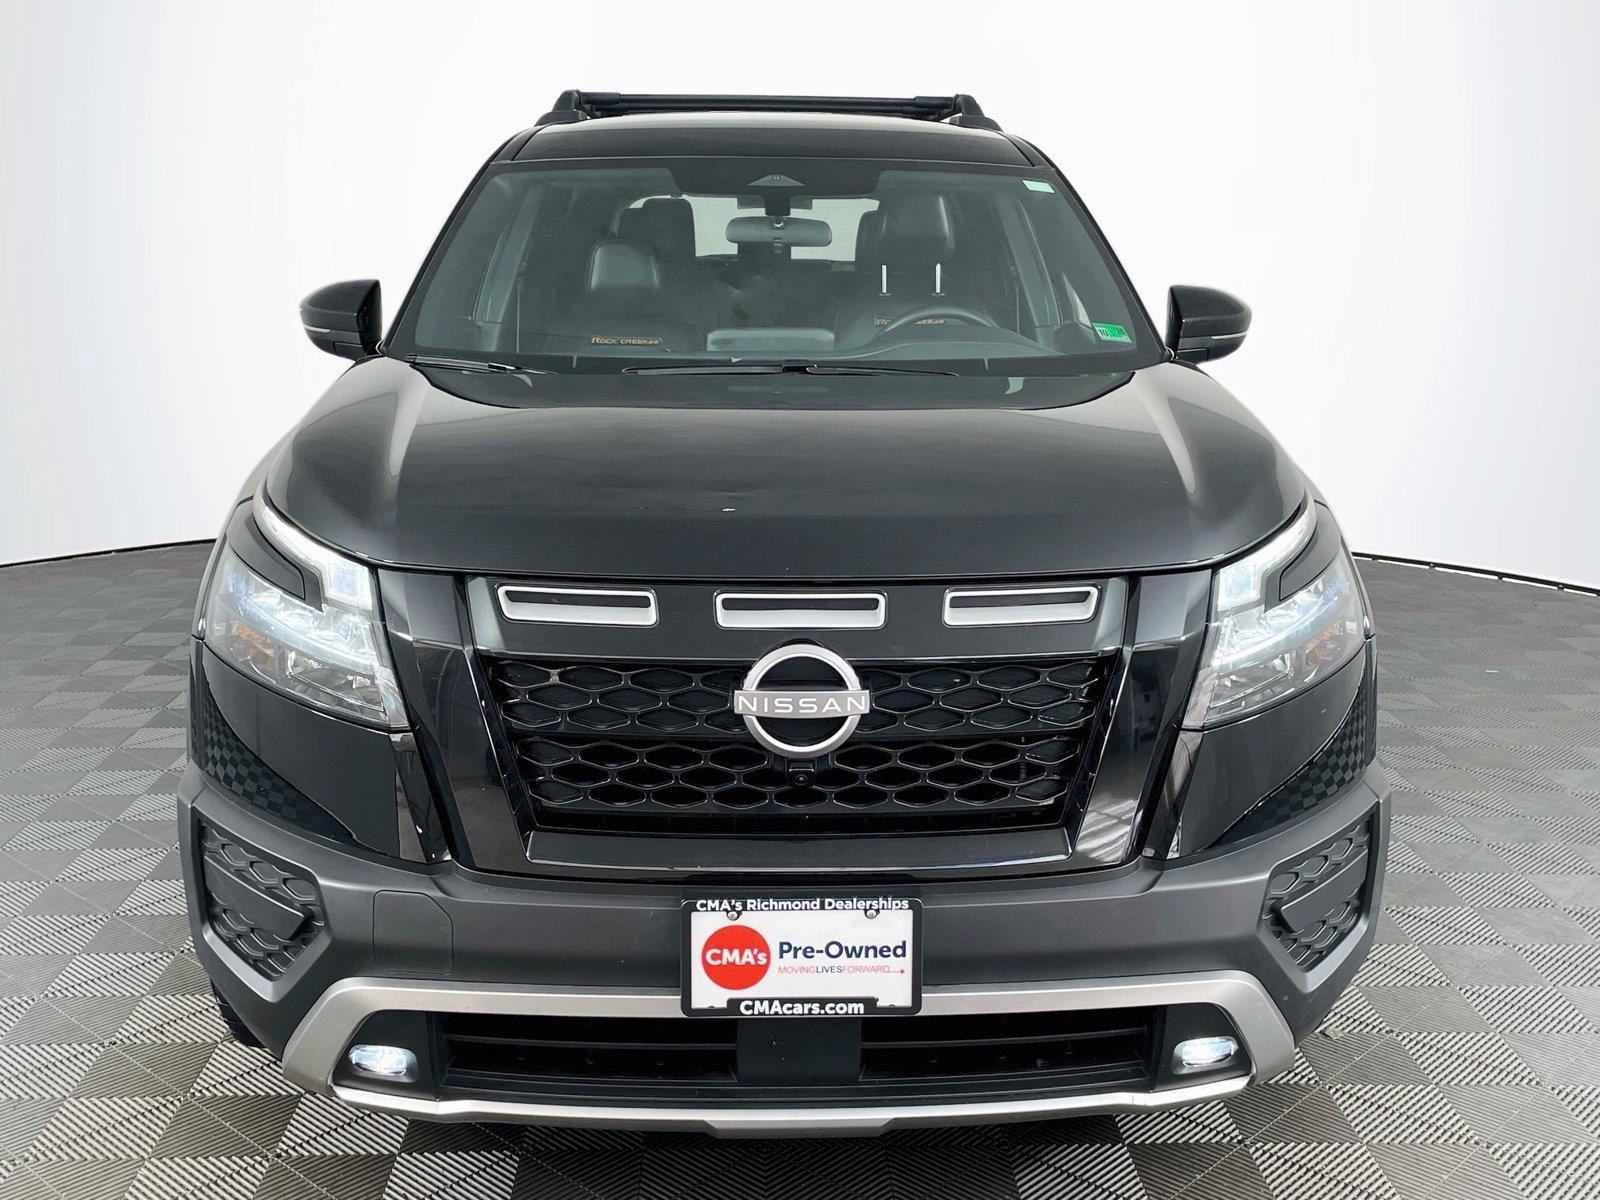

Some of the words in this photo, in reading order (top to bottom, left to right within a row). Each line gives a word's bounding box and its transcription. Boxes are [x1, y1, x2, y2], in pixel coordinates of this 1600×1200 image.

[738, 695, 865, 713] NISSAN
[696, 900, 743, 912] CMA's
[746, 898, 821, 911] Richmond
[825, 897, 909, 911] Dealerships
[705, 949, 767, 965] CMA's
[779, 940, 907, 959] Pre-Owned
[739, 1000, 864, 1015] CMAcars.com
